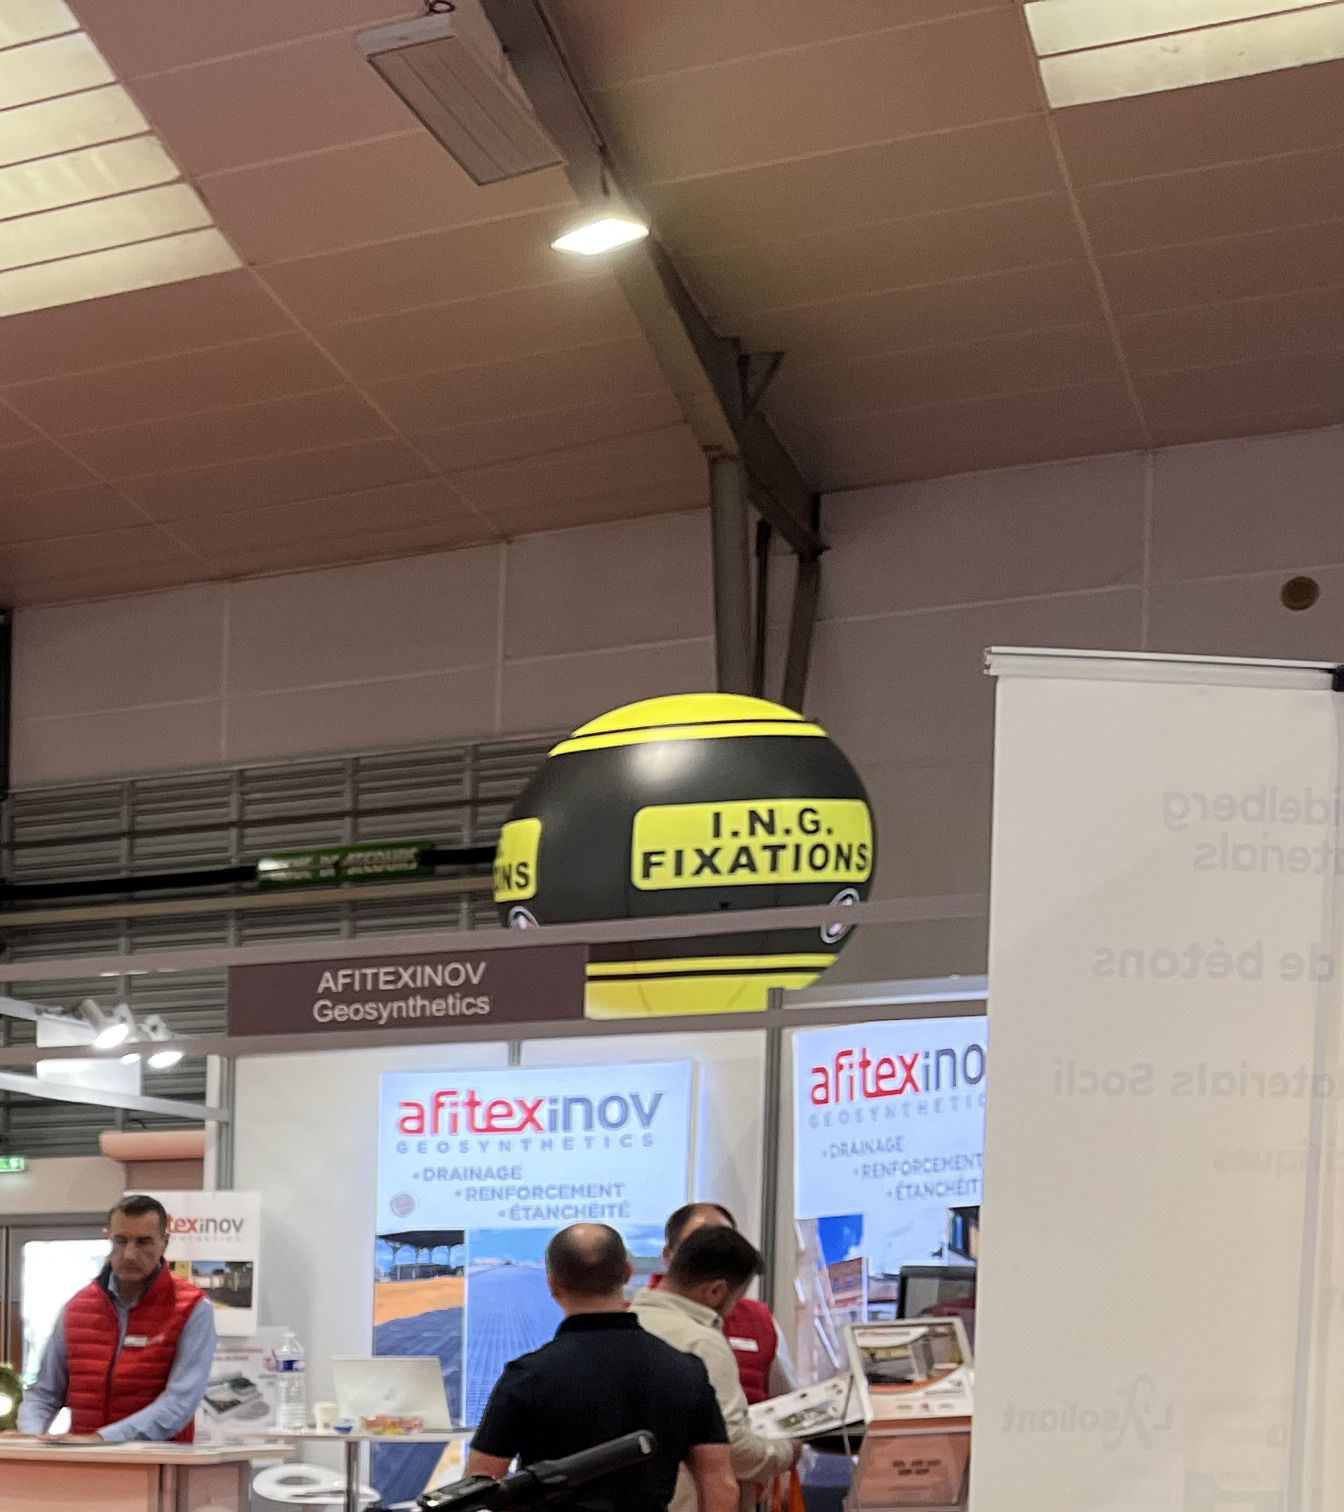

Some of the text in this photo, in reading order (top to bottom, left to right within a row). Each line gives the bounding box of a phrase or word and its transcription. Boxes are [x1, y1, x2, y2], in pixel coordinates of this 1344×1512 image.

[713, 807, 834, 839] I.N.G.
[642, 843, 869, 879] FIXATIONS
[317, 961, 487, 994] AFITEXINOV
[313, 992, 490, 1025] Geosynthetics
[811, 1044, 986, 1106] afitexino
[398, 1089, 665, 1135] afitexinov
[396, 1133, 655, 1154] GEOSYNTHETICS
[423, 1165, 523, 1181] DRAINAGE
[896, 1177, 980, 1200] ÉTANCHÉIT
[466, 1182, 626, 1201] RENFORCEMENT
